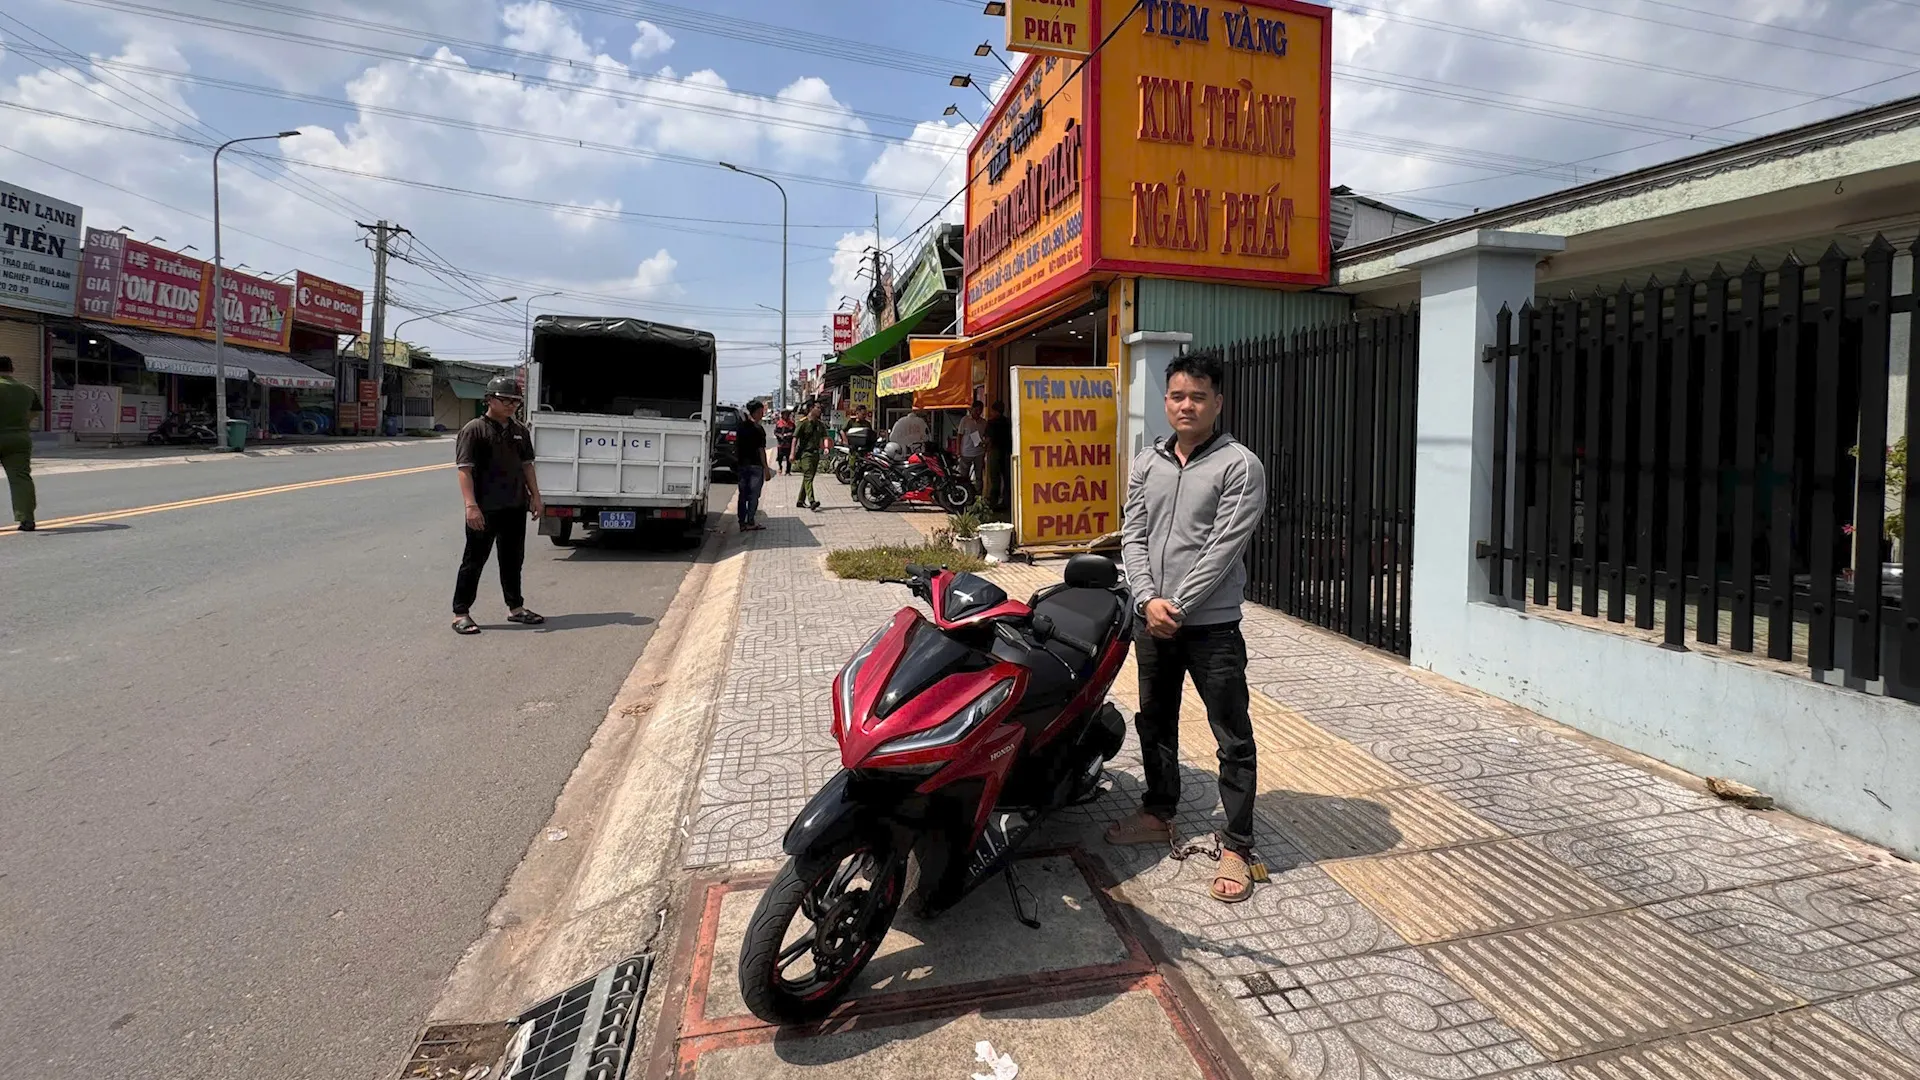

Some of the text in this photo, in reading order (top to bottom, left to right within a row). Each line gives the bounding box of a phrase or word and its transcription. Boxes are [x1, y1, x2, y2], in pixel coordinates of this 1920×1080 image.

[1025, 15, 1076, 45] PHÁT
[1142, 0, 1288, 57] TIỆM VÀNG
[1137, 75, 1296, 159] KIM THÀNH
[1041, 118, 1082, 216] PHÁT
[35, 203, 76, 227] LẠNH
[1131, 169, 1294, 259] NGÂN PHÁT
[86, 276, 111, 293] GIÁ
[156, 281, 200, 313] KIDS
[212, 273, 239, 293] ỬA
[212, 293, 245, 324] ỮA
[852, 377, 872, 389] PHOTO
[854, 391, 870, 402] COPY
[1024, 375, 1113, 403] TIỆM VÀNG
[1042, 409, 1097, 433] KIM
[585, 437, 651, 448] POLICE
[1029, 439, 1111, 468] THÀNH
[1033, 475, 1107, 504] NGÂN
[610, 512, 626, 521] 61A
[1037, 506, 1109, 537] PHÁT
[990, 743, 1015, 761] HONDA
